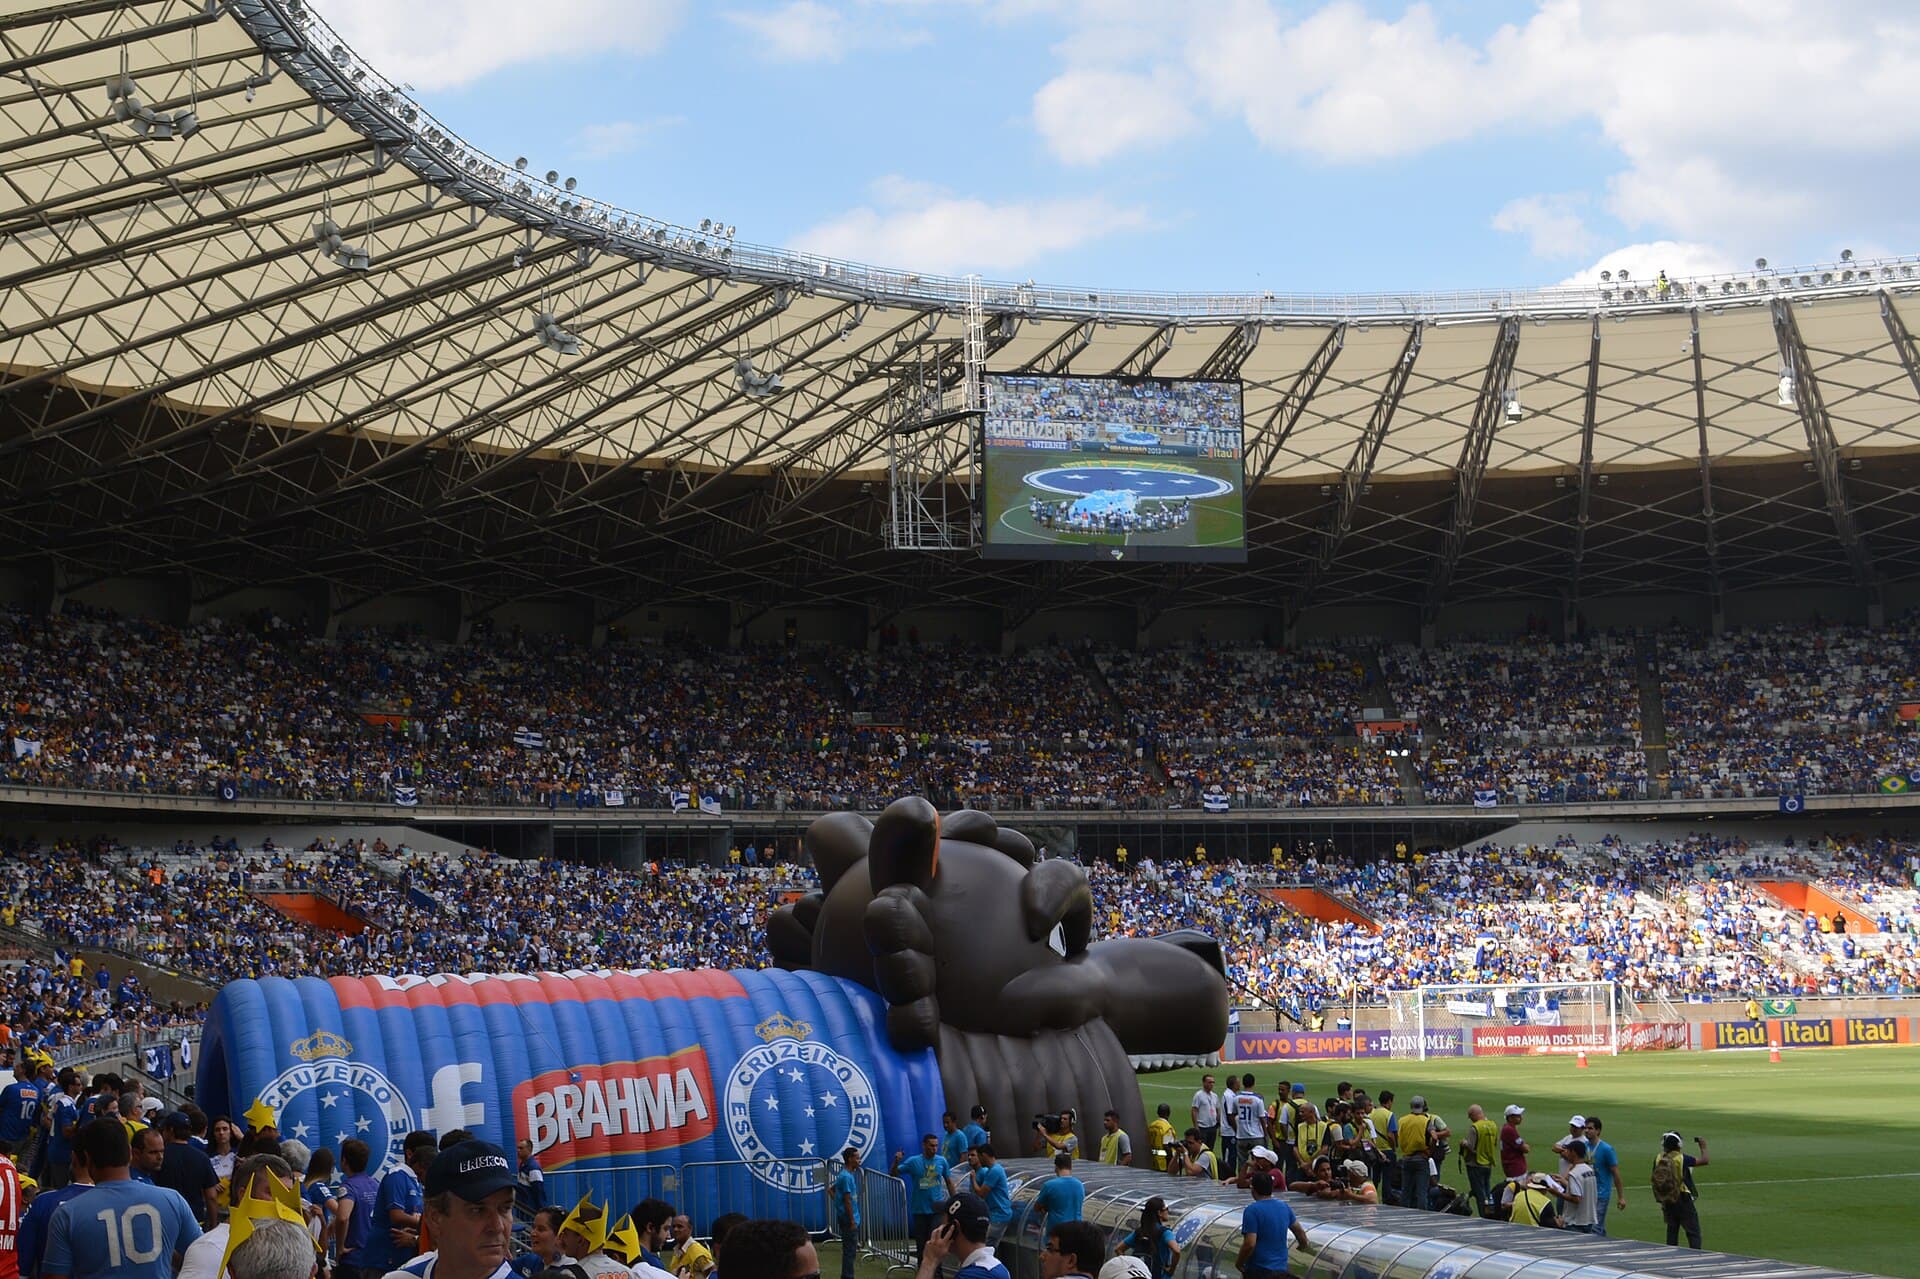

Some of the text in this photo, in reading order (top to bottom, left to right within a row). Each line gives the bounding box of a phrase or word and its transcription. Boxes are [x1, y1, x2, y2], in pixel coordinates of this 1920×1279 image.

[1477, 1033, 1605, 1048] NOVA BRAHMA DOS TIMES
[1718, 1022, 1765, 1045] Itaú
[1784, 1020, 1831, 1043] Itaú
[1848, 1018, 1895, 1042] Itaú
[1241, 1039, 1291, 1055] VIVO
[1295, 1036, 1367, 1054] SEMPRE
[738, 1044, 853, 1087] CRUZEIRO
[265, 1065, 391, 1111] CRUZEIRO
[20, 1101, 36, 1120] 10
[526, 1066, 708, 1155] BRAHMA
[1239, 1106, 1252, 1121] 31
[949, 1200, 961, 1215] 8
[97, 1203, 163, 1268] 10
